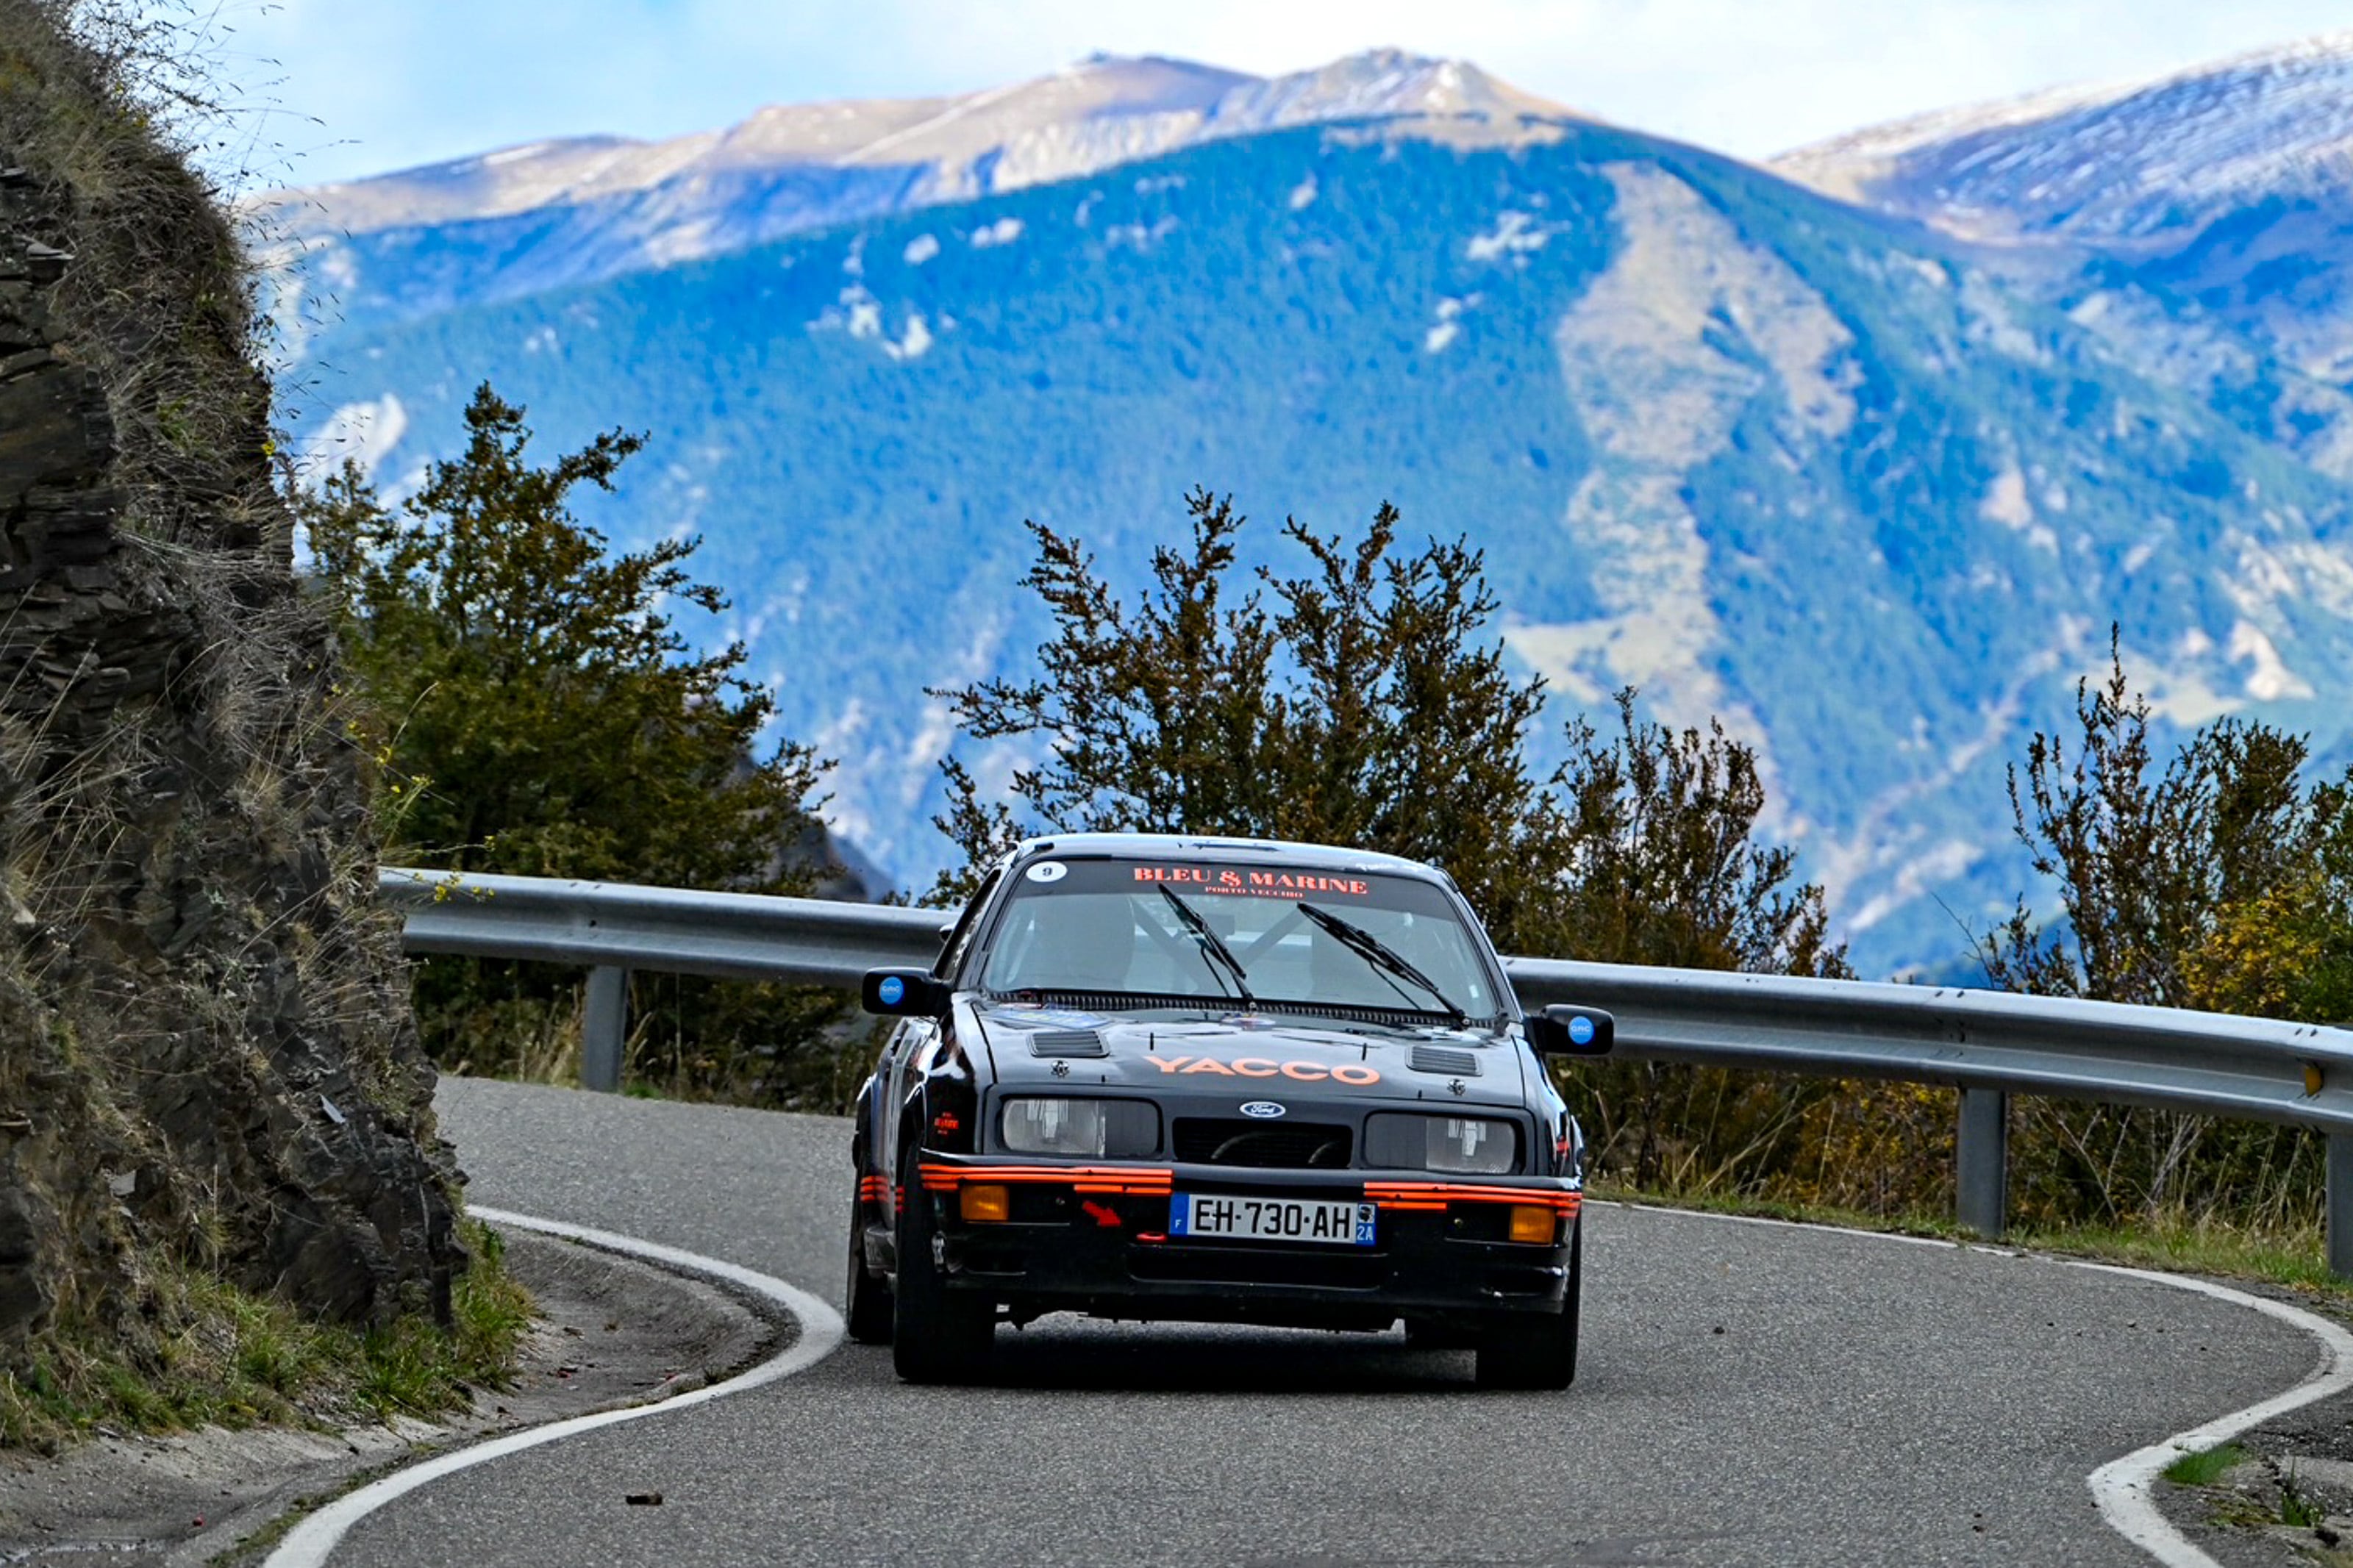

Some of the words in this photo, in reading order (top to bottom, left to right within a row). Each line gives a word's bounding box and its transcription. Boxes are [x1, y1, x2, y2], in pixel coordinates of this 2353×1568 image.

[1134, 867, 1211, 882] BLEU
[1219, 870, 1242, 887] &
[1249, 872, 1368, 895] MARINE
[1143, 1056, 1380, 1085] YACCO
[1174, 1219, 1182, 1229] F
[1357, 1225, 1374, 1241] 2A
